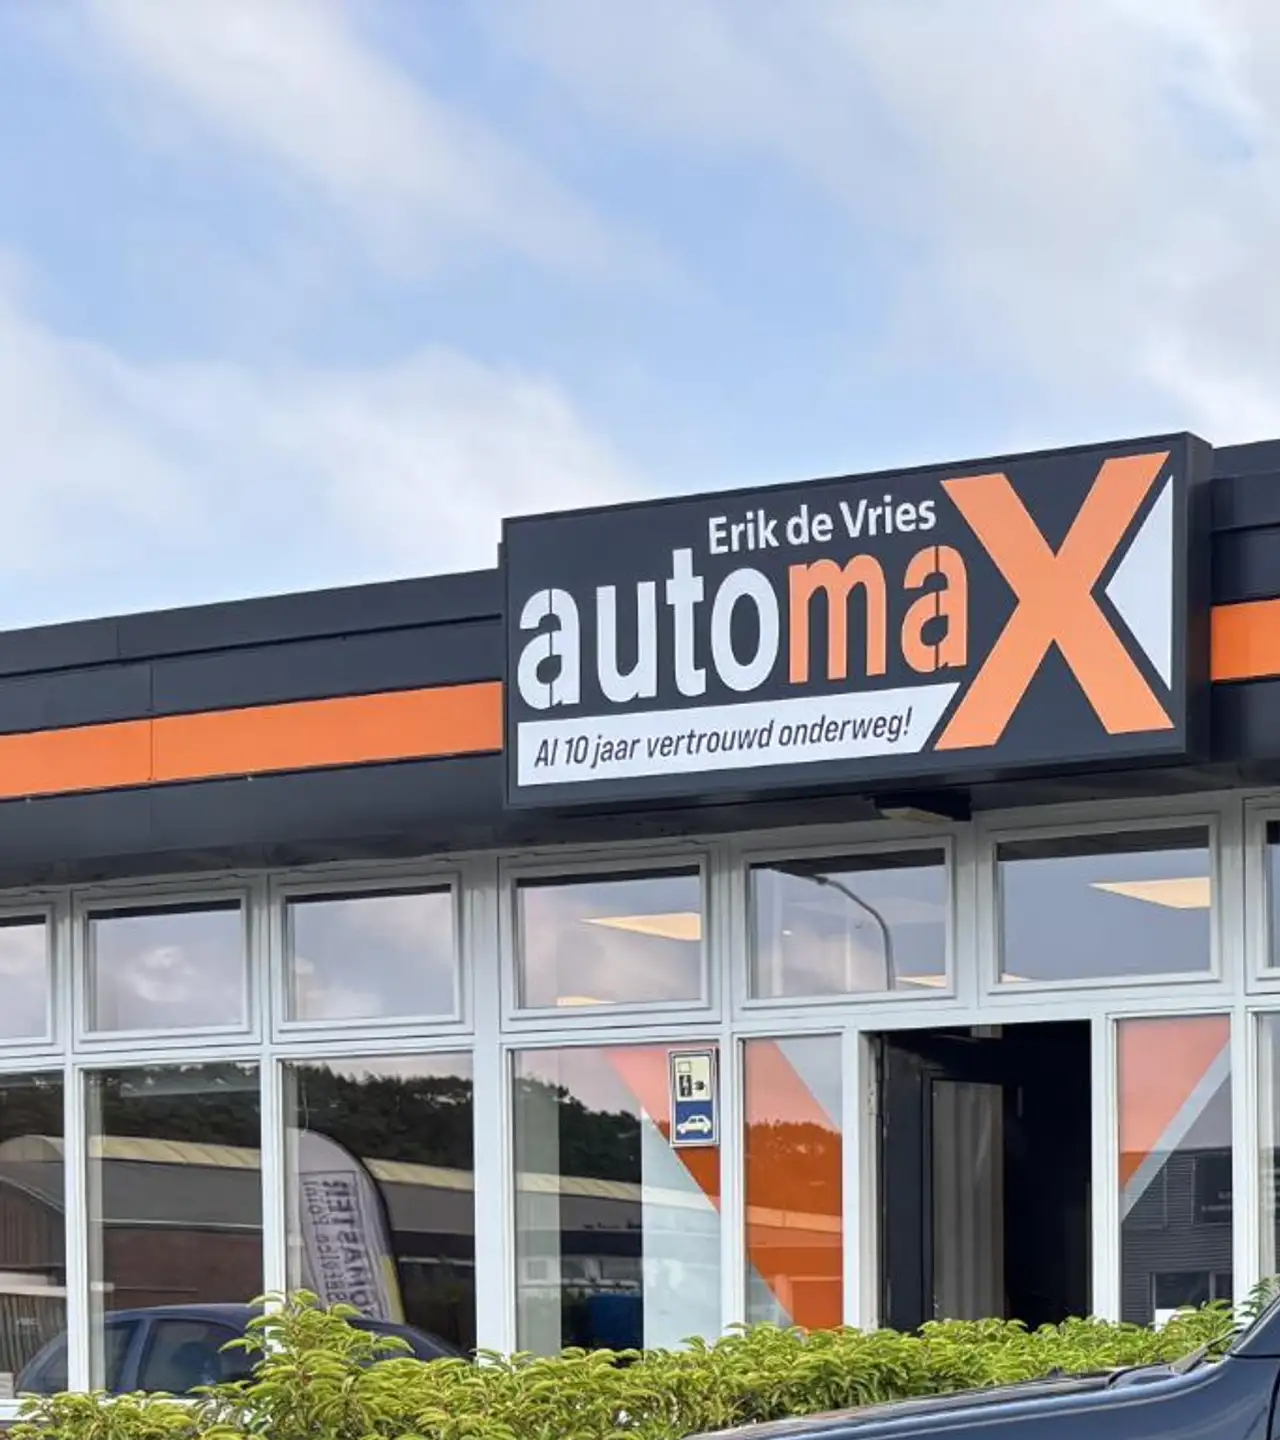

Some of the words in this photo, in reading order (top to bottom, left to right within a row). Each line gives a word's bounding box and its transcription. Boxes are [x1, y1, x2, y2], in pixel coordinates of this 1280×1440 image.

[708, 510, 780, 555] Erik
[785, 504, 833, 546] de
[839, 494, 937, 538] Vries
[534, 738, 558, 768] Al
[564, 734, 589, 766] 10
[591, 732, 640, 770] jaar
[646, 720, 776, 759] vertrouwd
[777, 706, 914, 748] onderweg!
